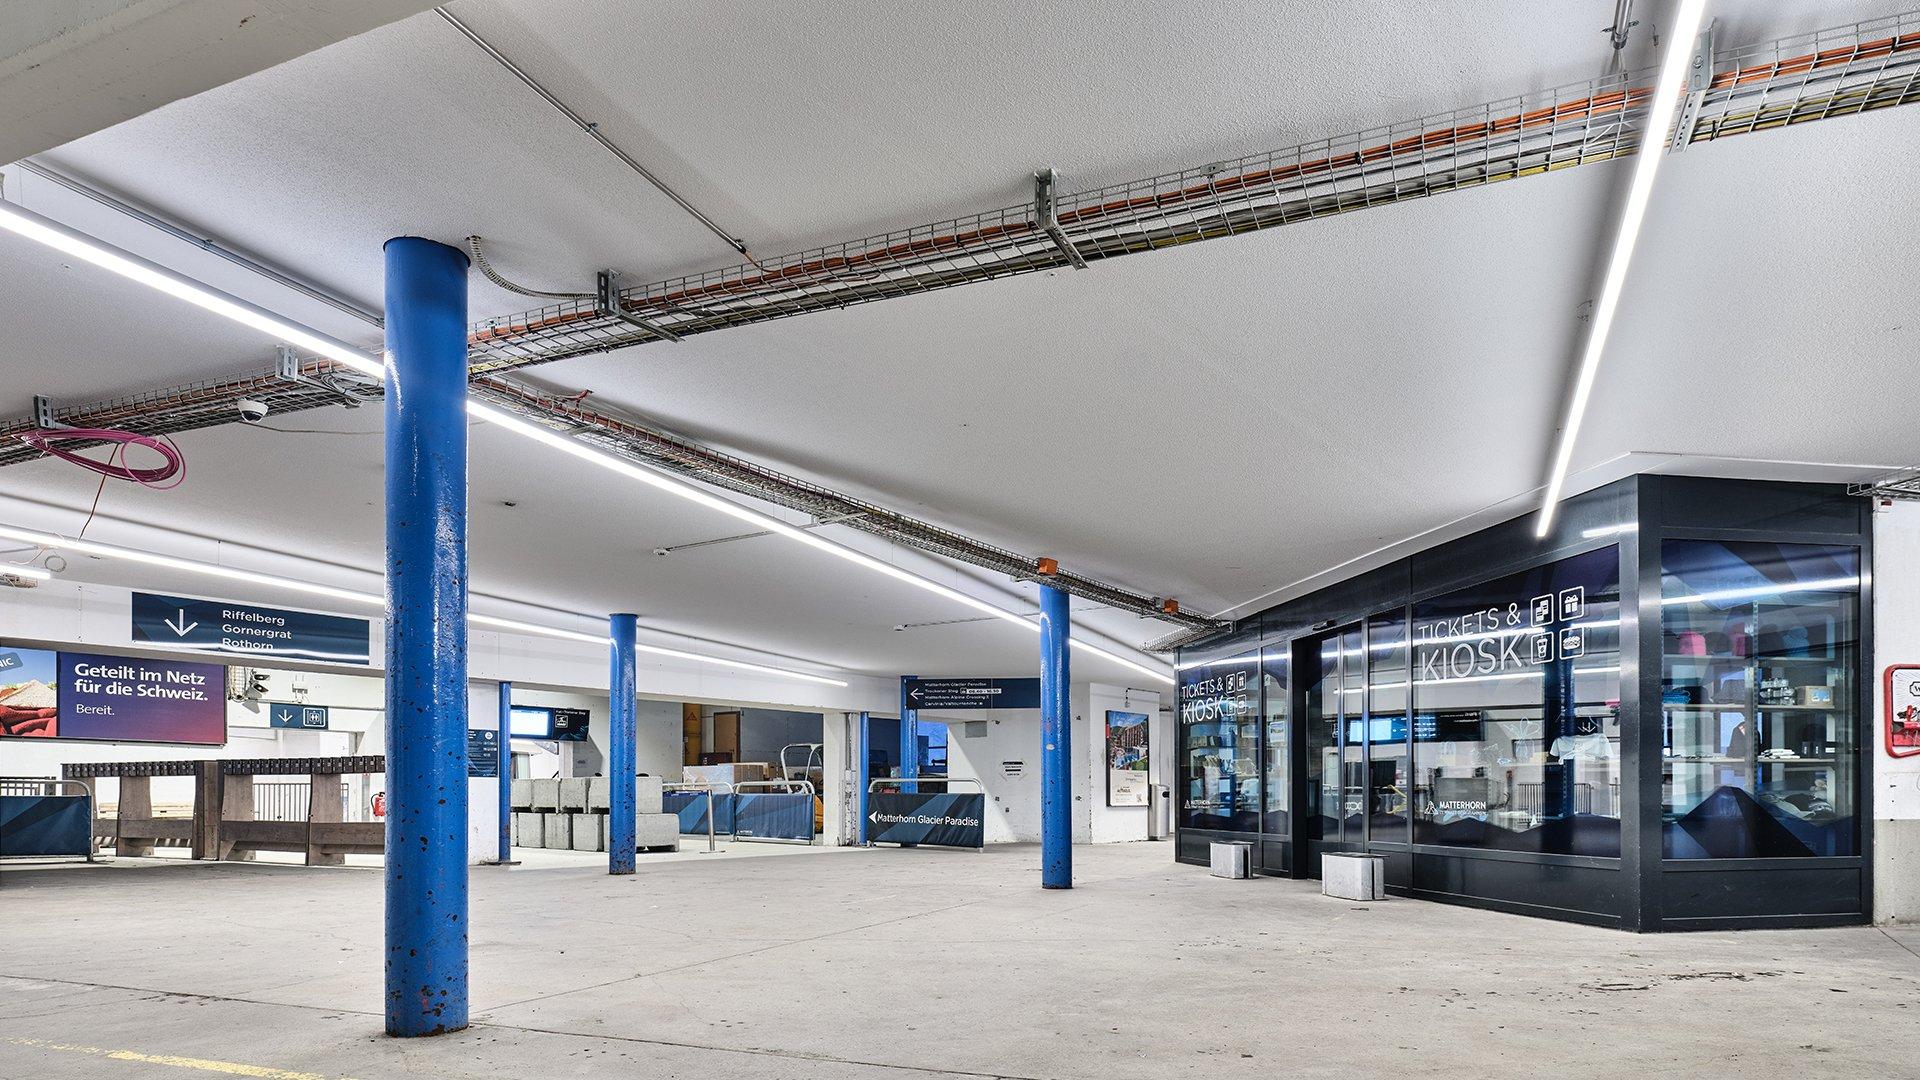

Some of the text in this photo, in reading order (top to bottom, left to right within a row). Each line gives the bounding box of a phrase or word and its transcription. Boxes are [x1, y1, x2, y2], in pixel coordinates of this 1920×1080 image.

[222, 610, 285, 627] Riffelberg
[1418, 602, 1521, 645] TICKETS &
[222, 623, 292, 639] Gornergrat
[222, 637, 273, 650] Rothorn
[1422, 632, 1525, 682] KIOSK
[74, 663, 206, 685] Geteilt im Netz
[74, 679, 208, 701] für die Schweiz.
[1181, 676, 1223, 699] TICKETS &
[76, 703, 115, 716] Bereit.
[1183, 695, 1224, 724] KIOSK
[1440, 801, 1487, 810] MATTERHORN
[877, 814, 979, 827] Matterhorn Glacier Paradise
